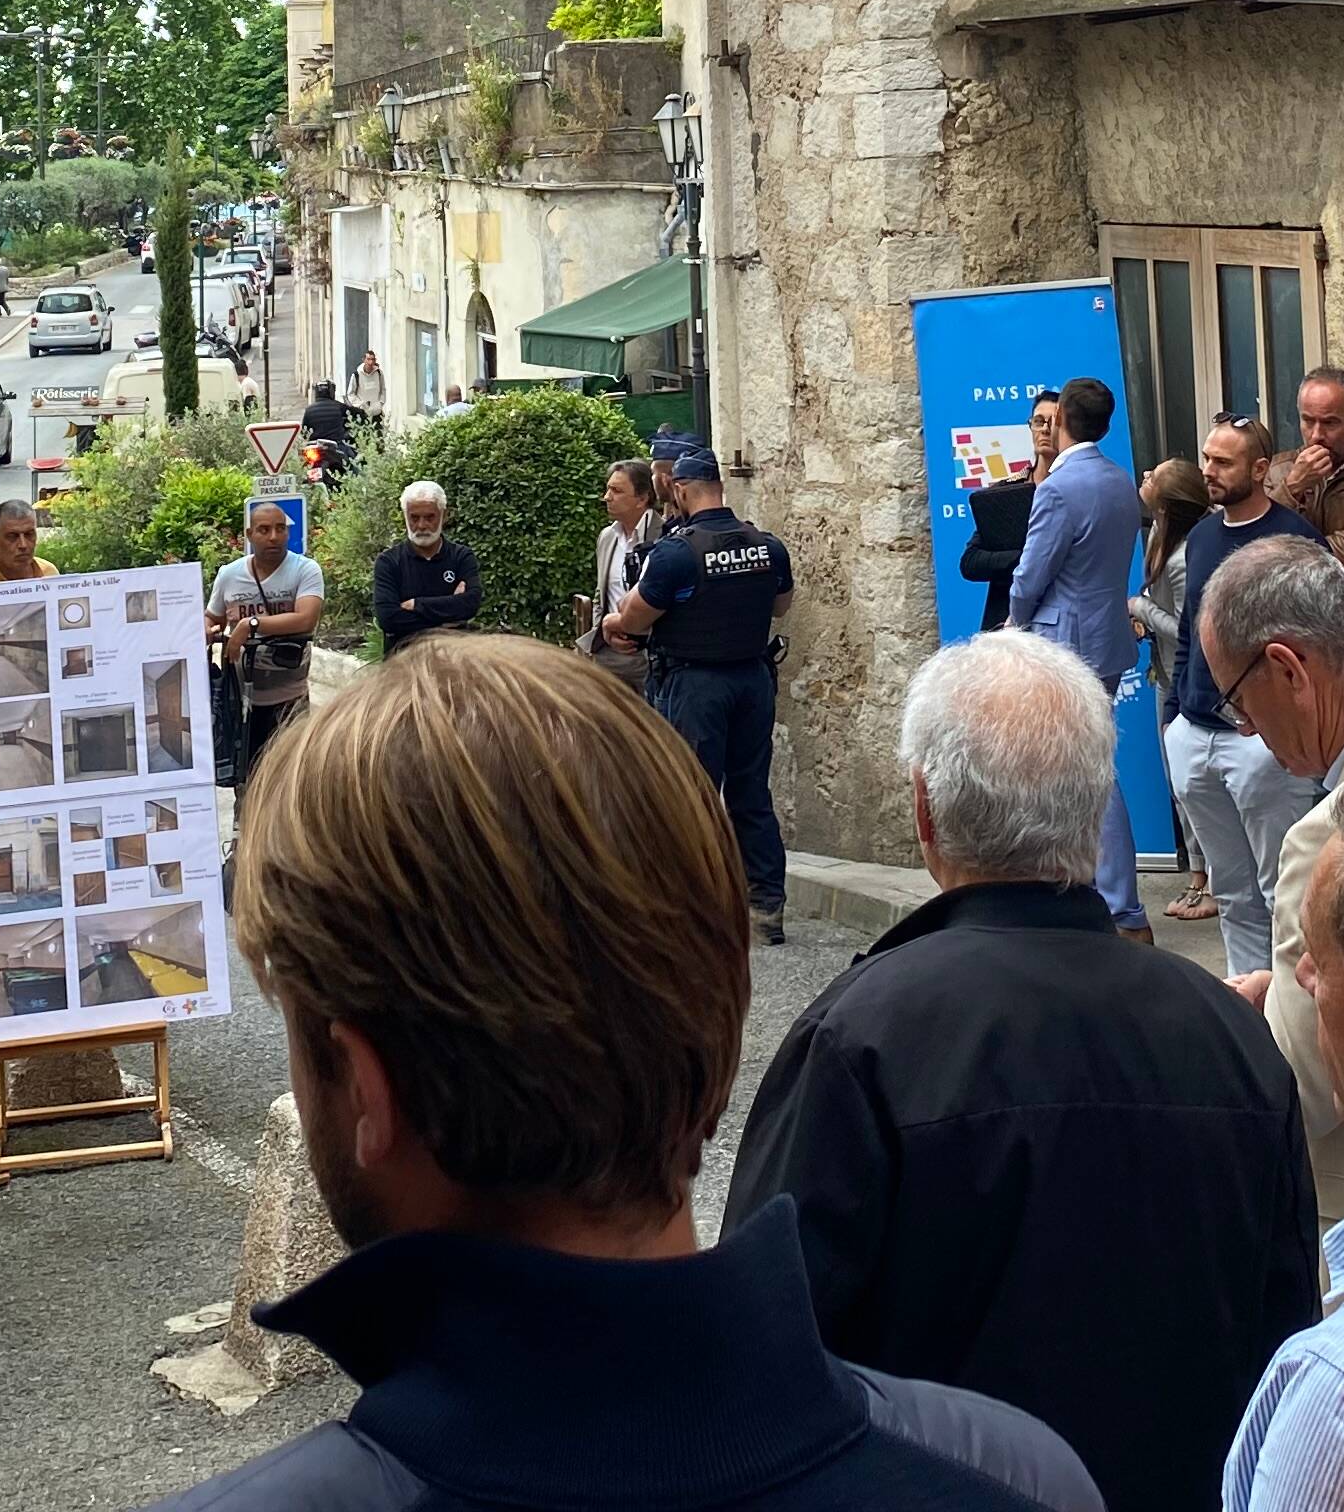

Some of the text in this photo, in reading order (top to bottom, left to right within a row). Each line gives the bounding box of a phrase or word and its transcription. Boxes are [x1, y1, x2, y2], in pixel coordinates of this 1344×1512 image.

[973, 385, 1019, 402] PAYS
[261, 486, 289, 494] PASSAGE
[942, 504, 967, 518] DE
[705, 545, 769, 567] POLICE
[81, 580, 91, 588] de
[93, 578, 101, 586] la
[103, 576, 120, 585] ville
